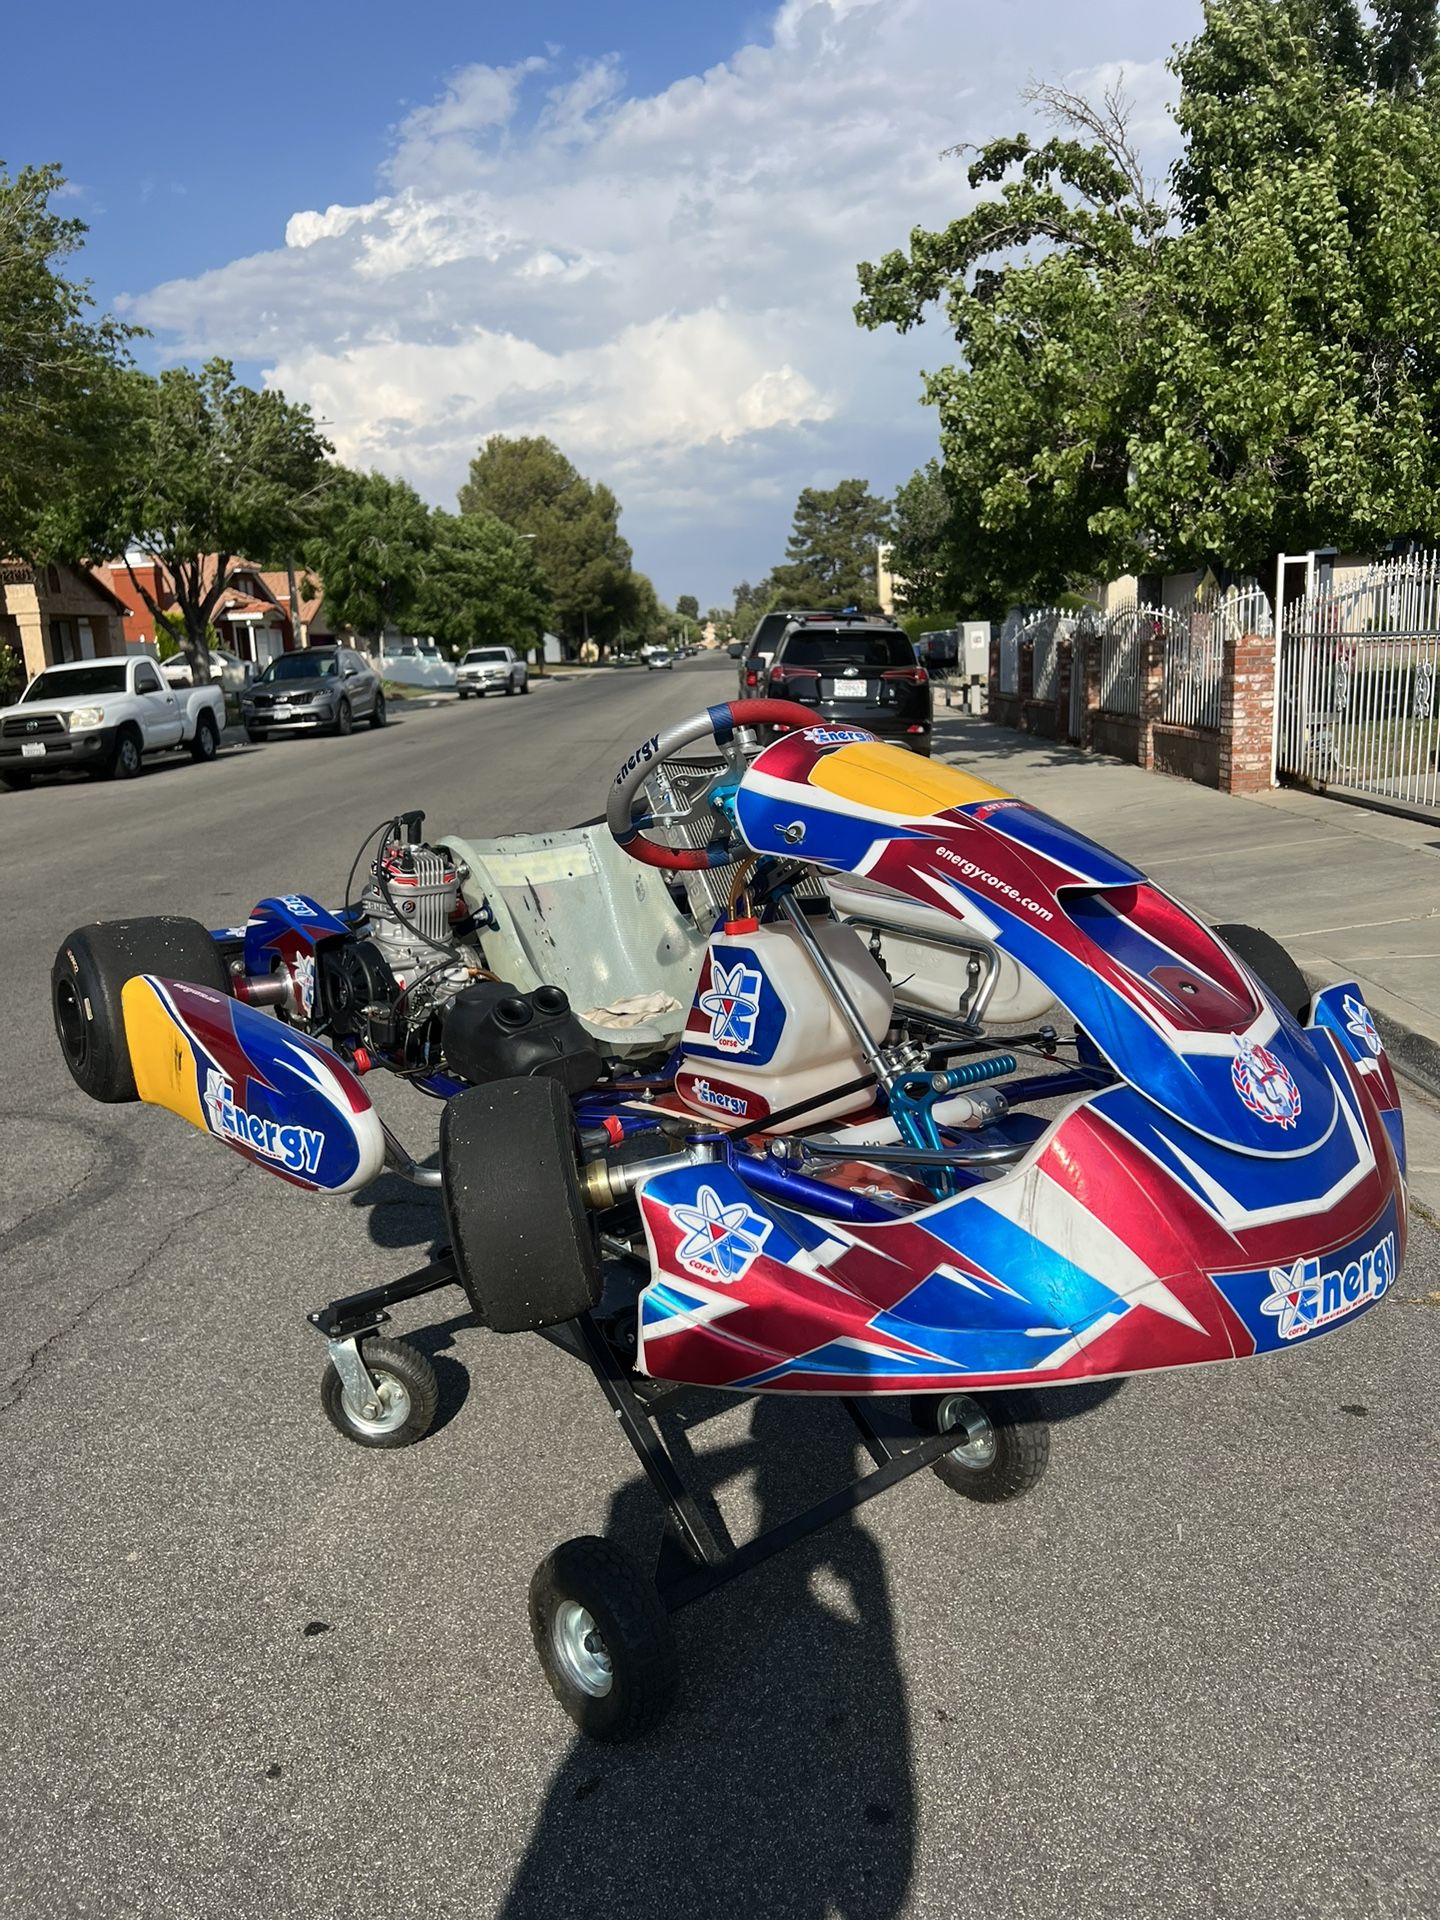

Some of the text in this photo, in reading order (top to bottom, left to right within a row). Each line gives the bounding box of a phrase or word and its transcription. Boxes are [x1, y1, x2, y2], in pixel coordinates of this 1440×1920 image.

[935, 846, 1054, 922] energycorse.com
[719, 1038, 738, 1048] corse
[701, 1083, 747, 1115] Energy
[222, 1086, 322, 1172] Energy
[689, 1259, 718, 1277] corse
[1292, 1233, 1394, 1326] Energy
[1288, 1323, 1308, 1336] corse
